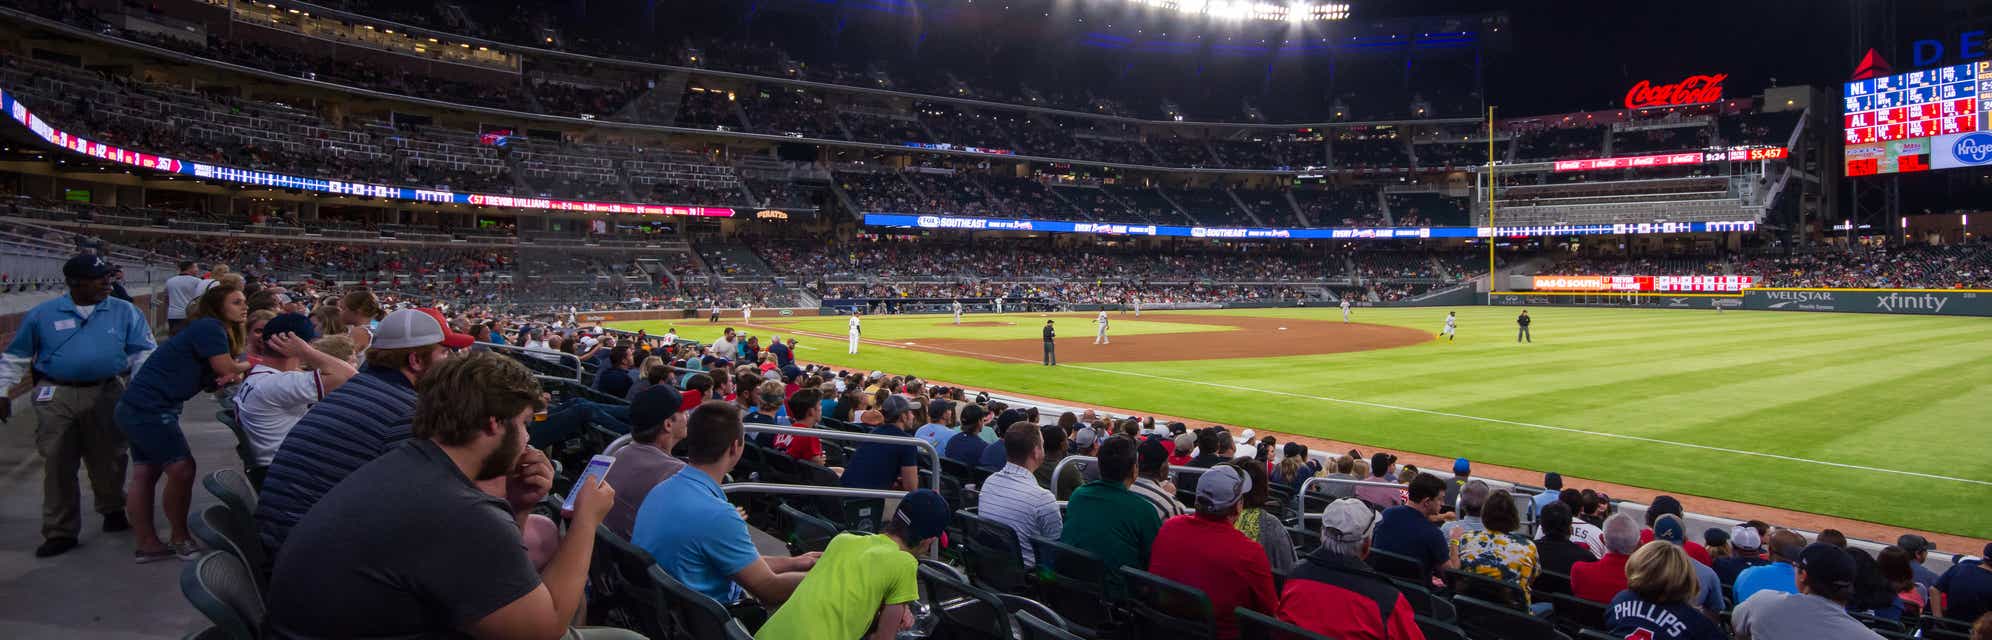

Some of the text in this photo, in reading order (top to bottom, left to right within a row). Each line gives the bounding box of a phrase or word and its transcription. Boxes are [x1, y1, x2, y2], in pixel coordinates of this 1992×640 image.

[1625, 73, 1728, 109] Coca-Cola
[1851, 82, 1867, 96] NL
[1851, 114, 1867, 127] AL
[1706, 153, 1726, 161] 9:24
[1751, 149, 1781, 160] $5,457
[474, 195, 483, 204] 57
[485, 196, 513, 207] TREVOR
[514, 198, 550, 209] WILLIAMS
[941, 218, 986, 228] SOUTHEAST
[1206, 228, 1247, 237] SOUTHEAST
[1567, 279, 1600, 288] SOUTH
[1877, 293, 1948, 312] xfinity
[1614, 600, 1687, 637] PHILLIPS
